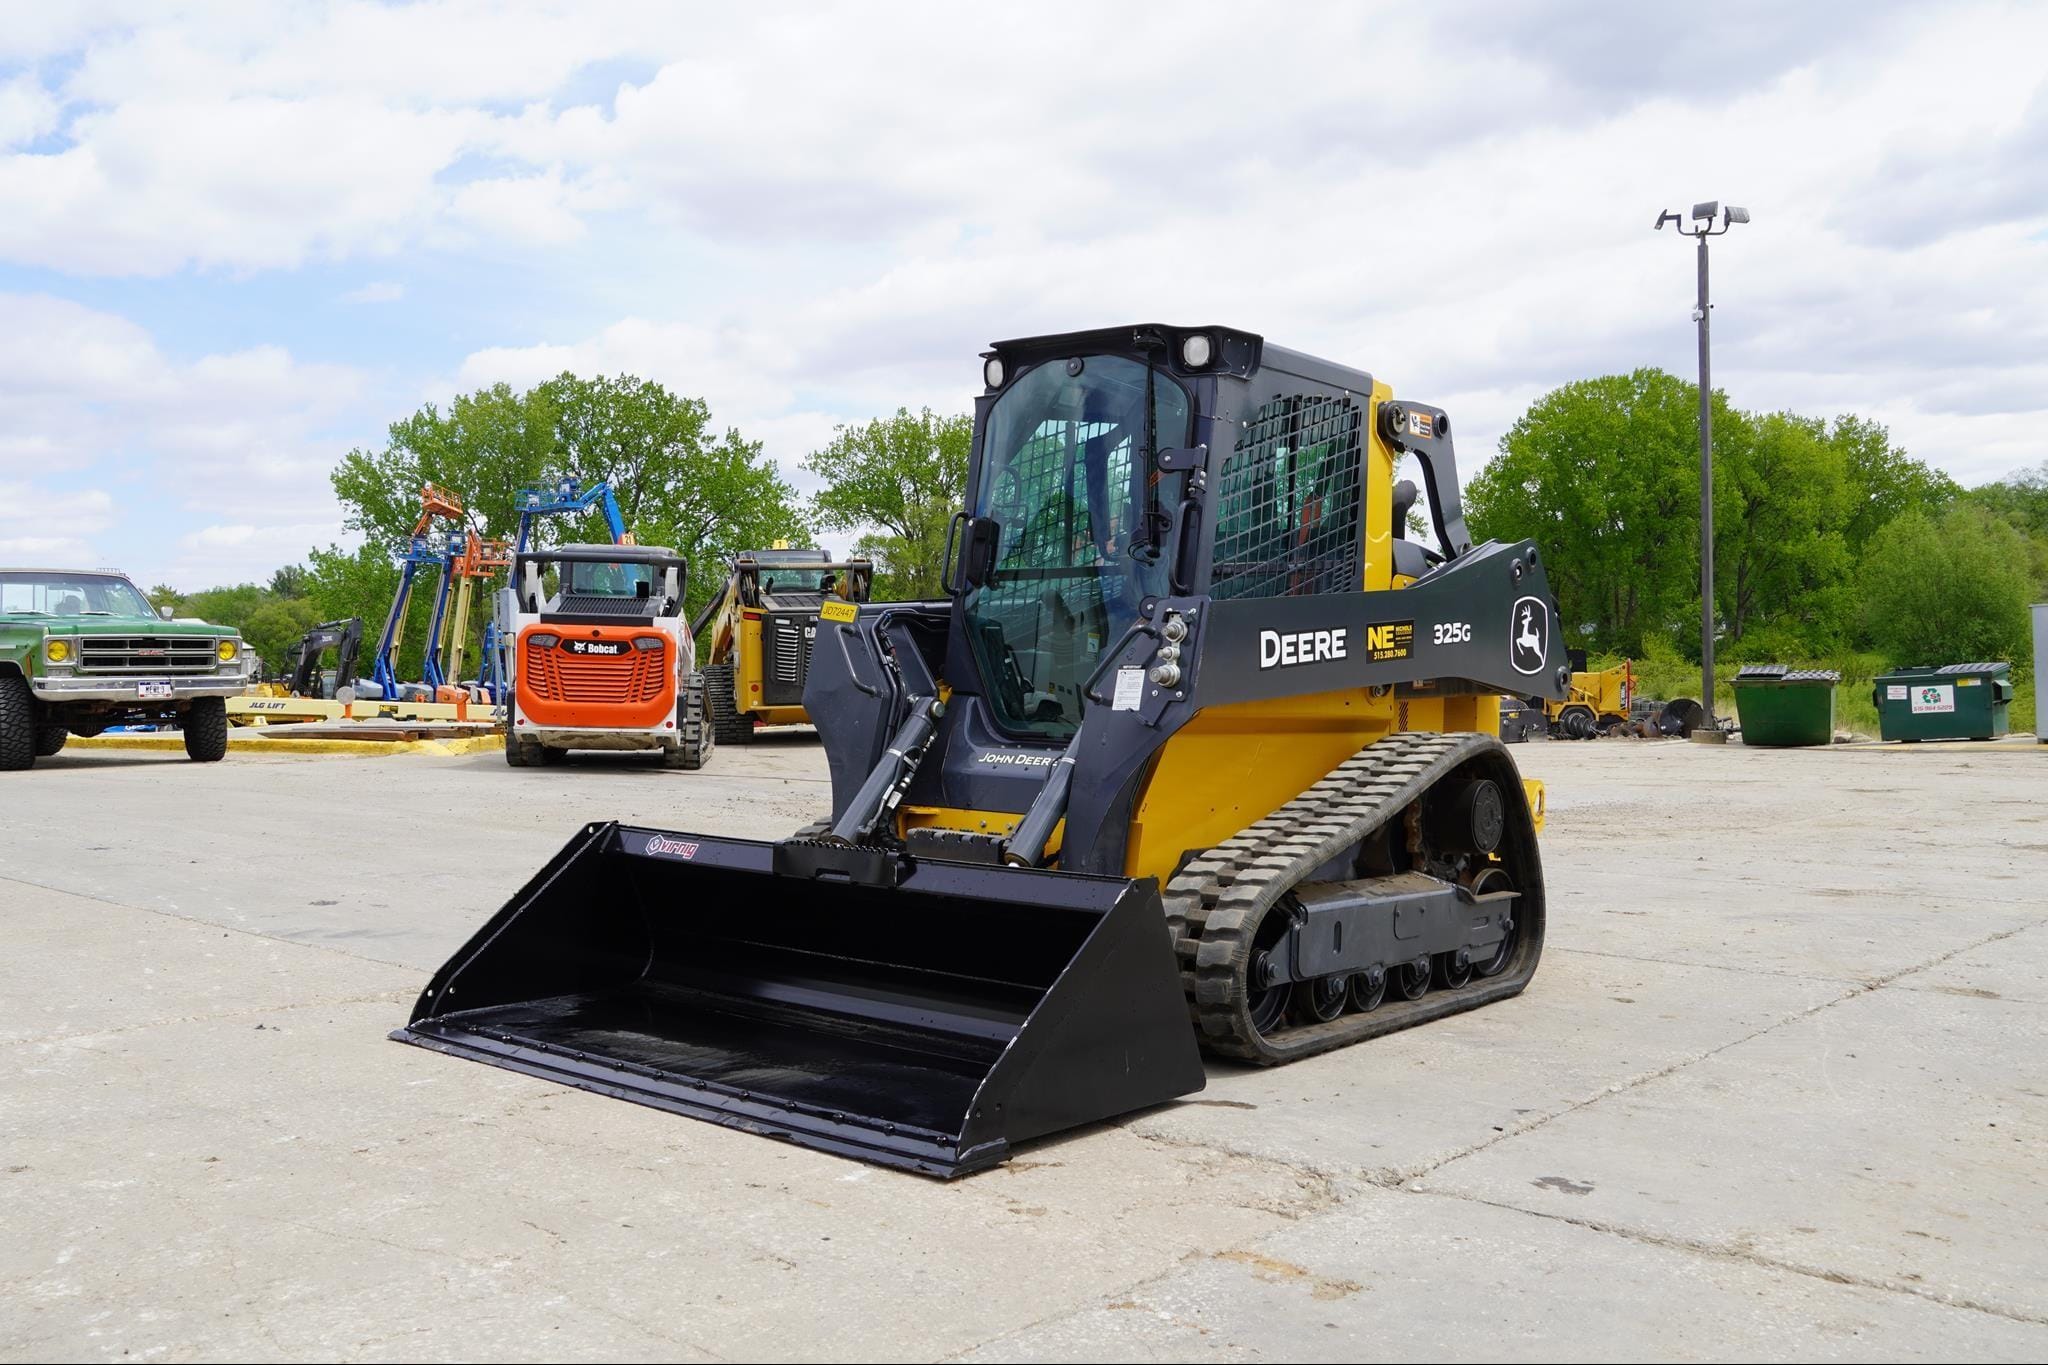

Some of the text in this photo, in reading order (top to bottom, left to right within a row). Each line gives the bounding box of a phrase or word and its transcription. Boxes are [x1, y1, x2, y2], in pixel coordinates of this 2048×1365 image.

[823, 606, 855, 618] JD72447
[804, 626, 817, 638] CA
[1367, 625, 1395, 651] NE
[1433, 622, 1471, 645] 325G
[588, 643, 618, 654] Bobcat
[1260, 628, 1347, 668] DEERE
[978, 752, 1015, 764] JOHN
